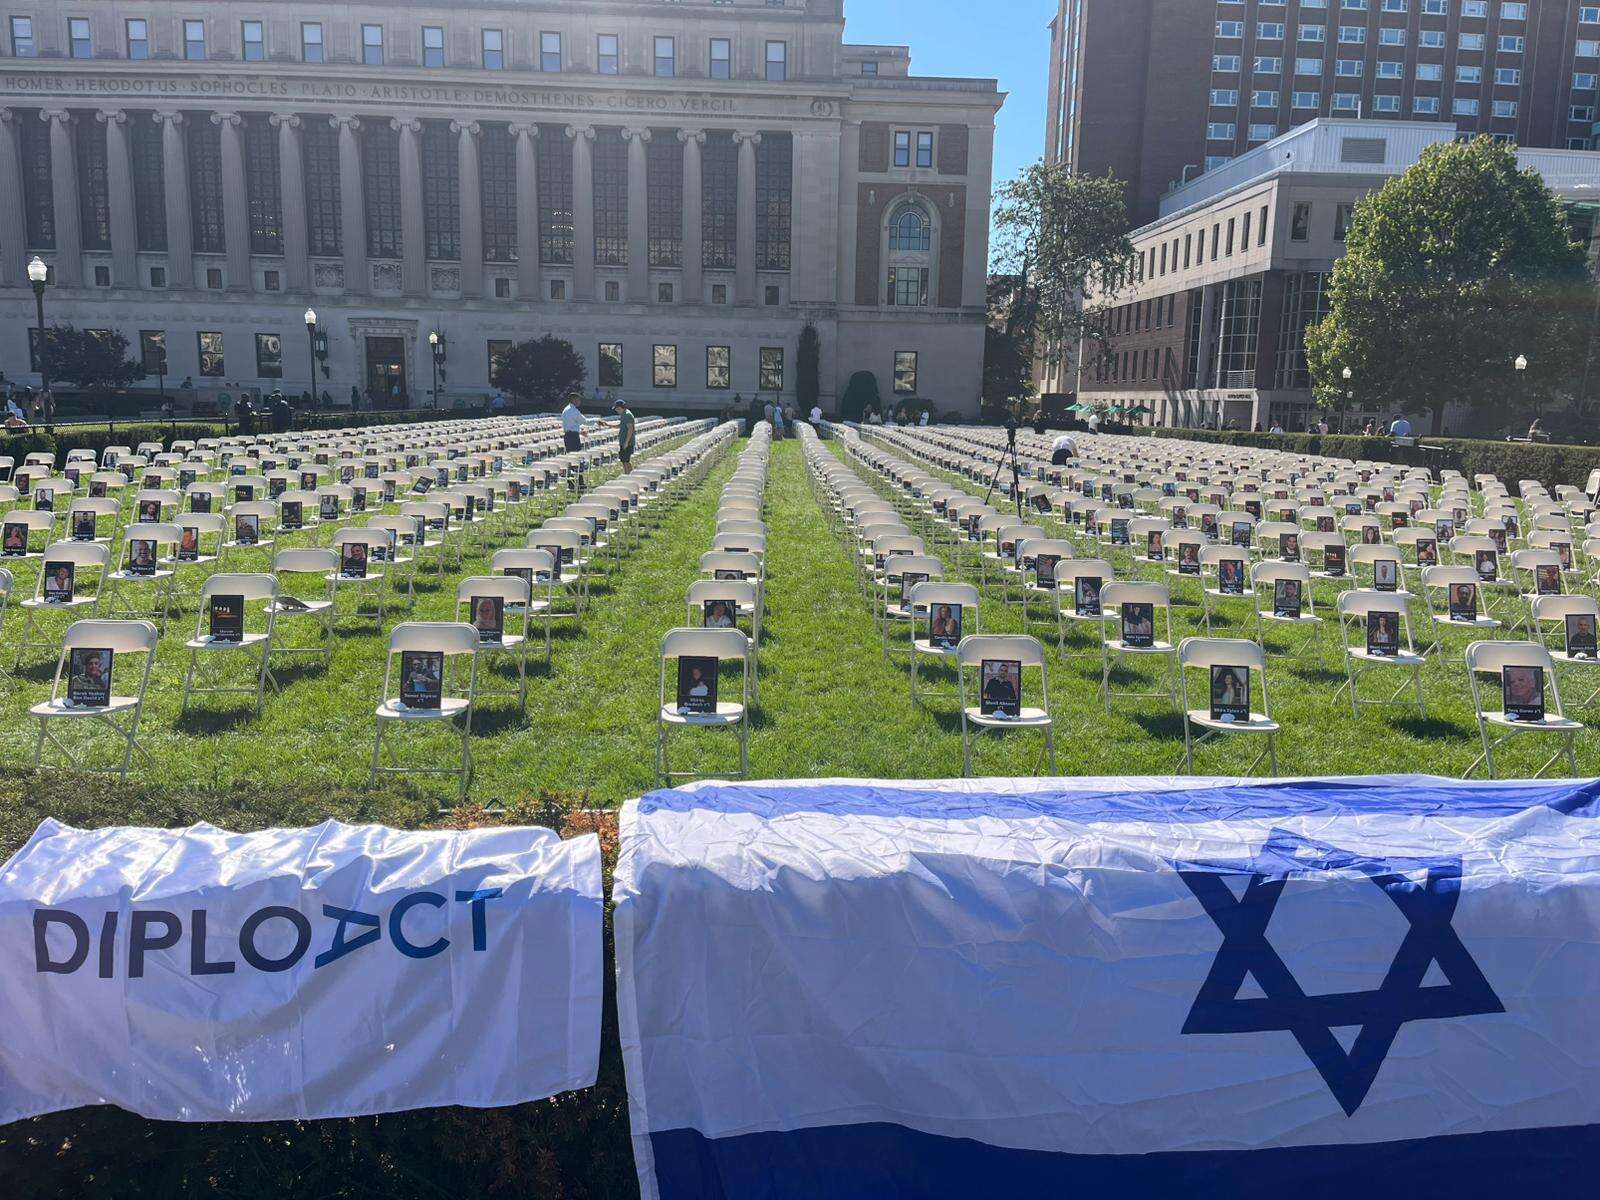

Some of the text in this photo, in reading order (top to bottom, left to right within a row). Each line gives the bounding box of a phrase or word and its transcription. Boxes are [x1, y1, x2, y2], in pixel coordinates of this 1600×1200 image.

[5, 77, 737, 112] HOMER HERODOTUS SOPHOCLES PLATO ARISTOTLE DEMOSTHENES CICERO VERGIL
[33, 888, 502, 979] DIPLOACT
